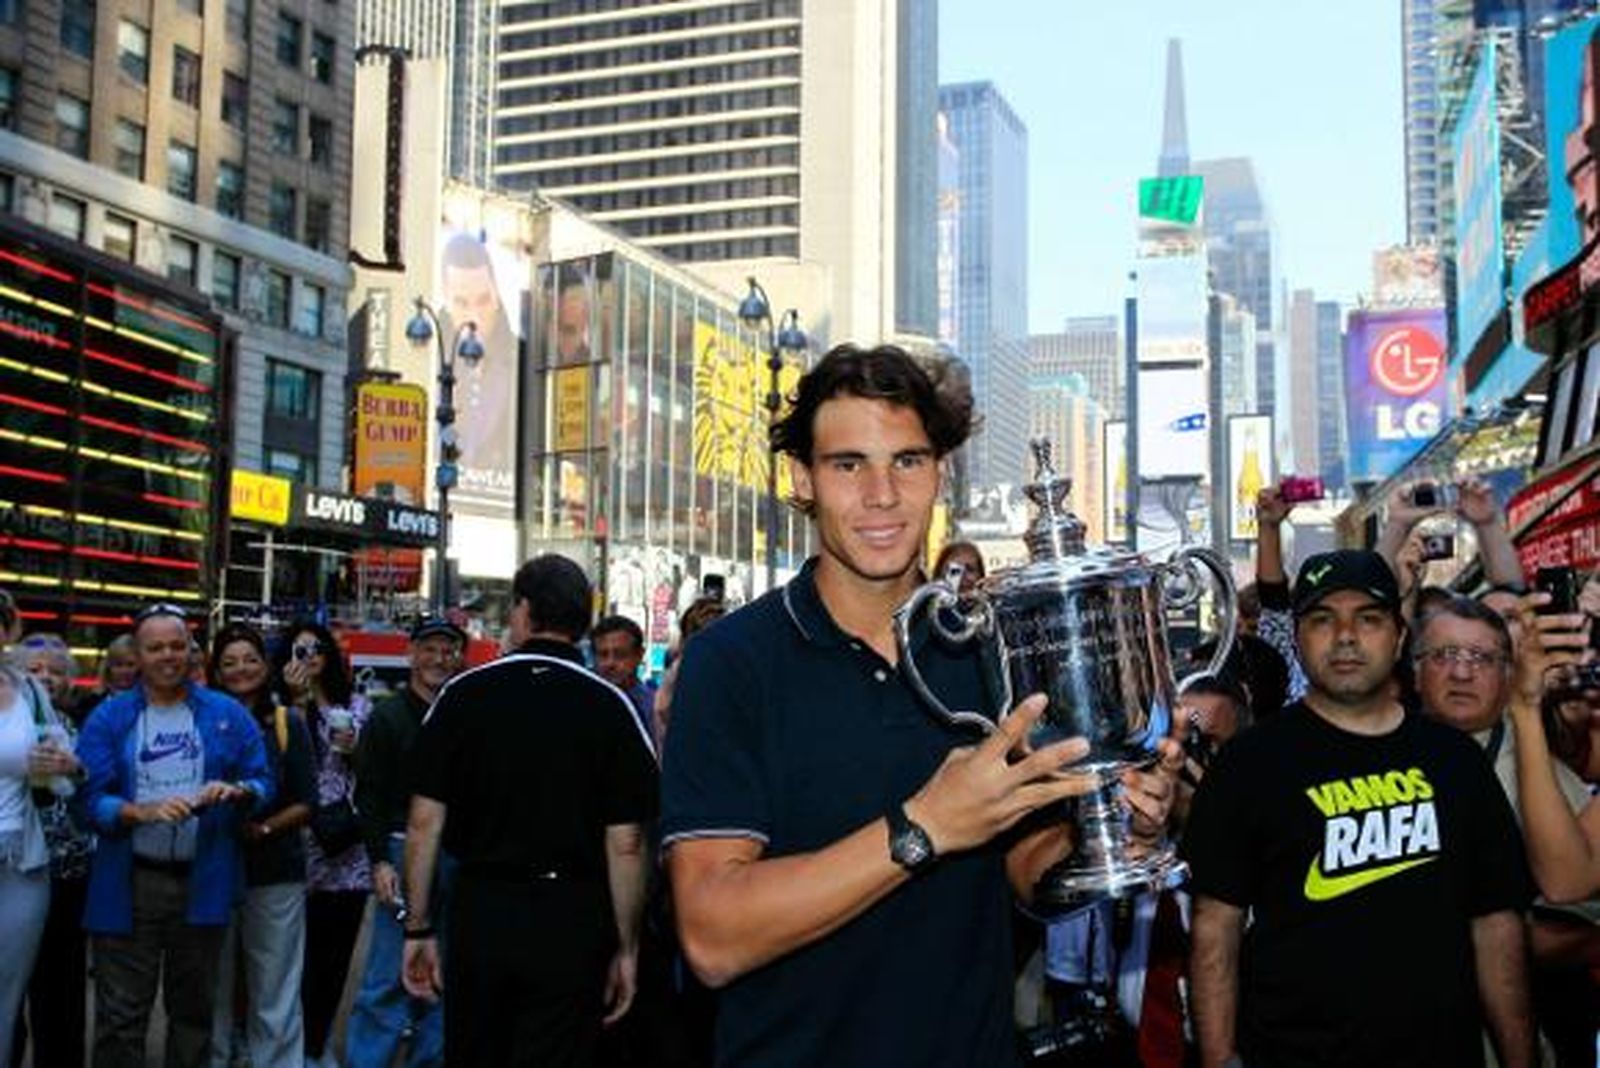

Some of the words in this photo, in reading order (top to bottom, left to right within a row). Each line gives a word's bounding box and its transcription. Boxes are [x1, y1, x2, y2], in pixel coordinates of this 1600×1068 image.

[362, 393, 422, 420] BUBBA
[1376, 401, 1440, 440] LG
[365, 423, 419, 441] GUMP
[1306, 766, 1434, 817] VAMOS
[1324, 801, 1441, 872] RAFA
